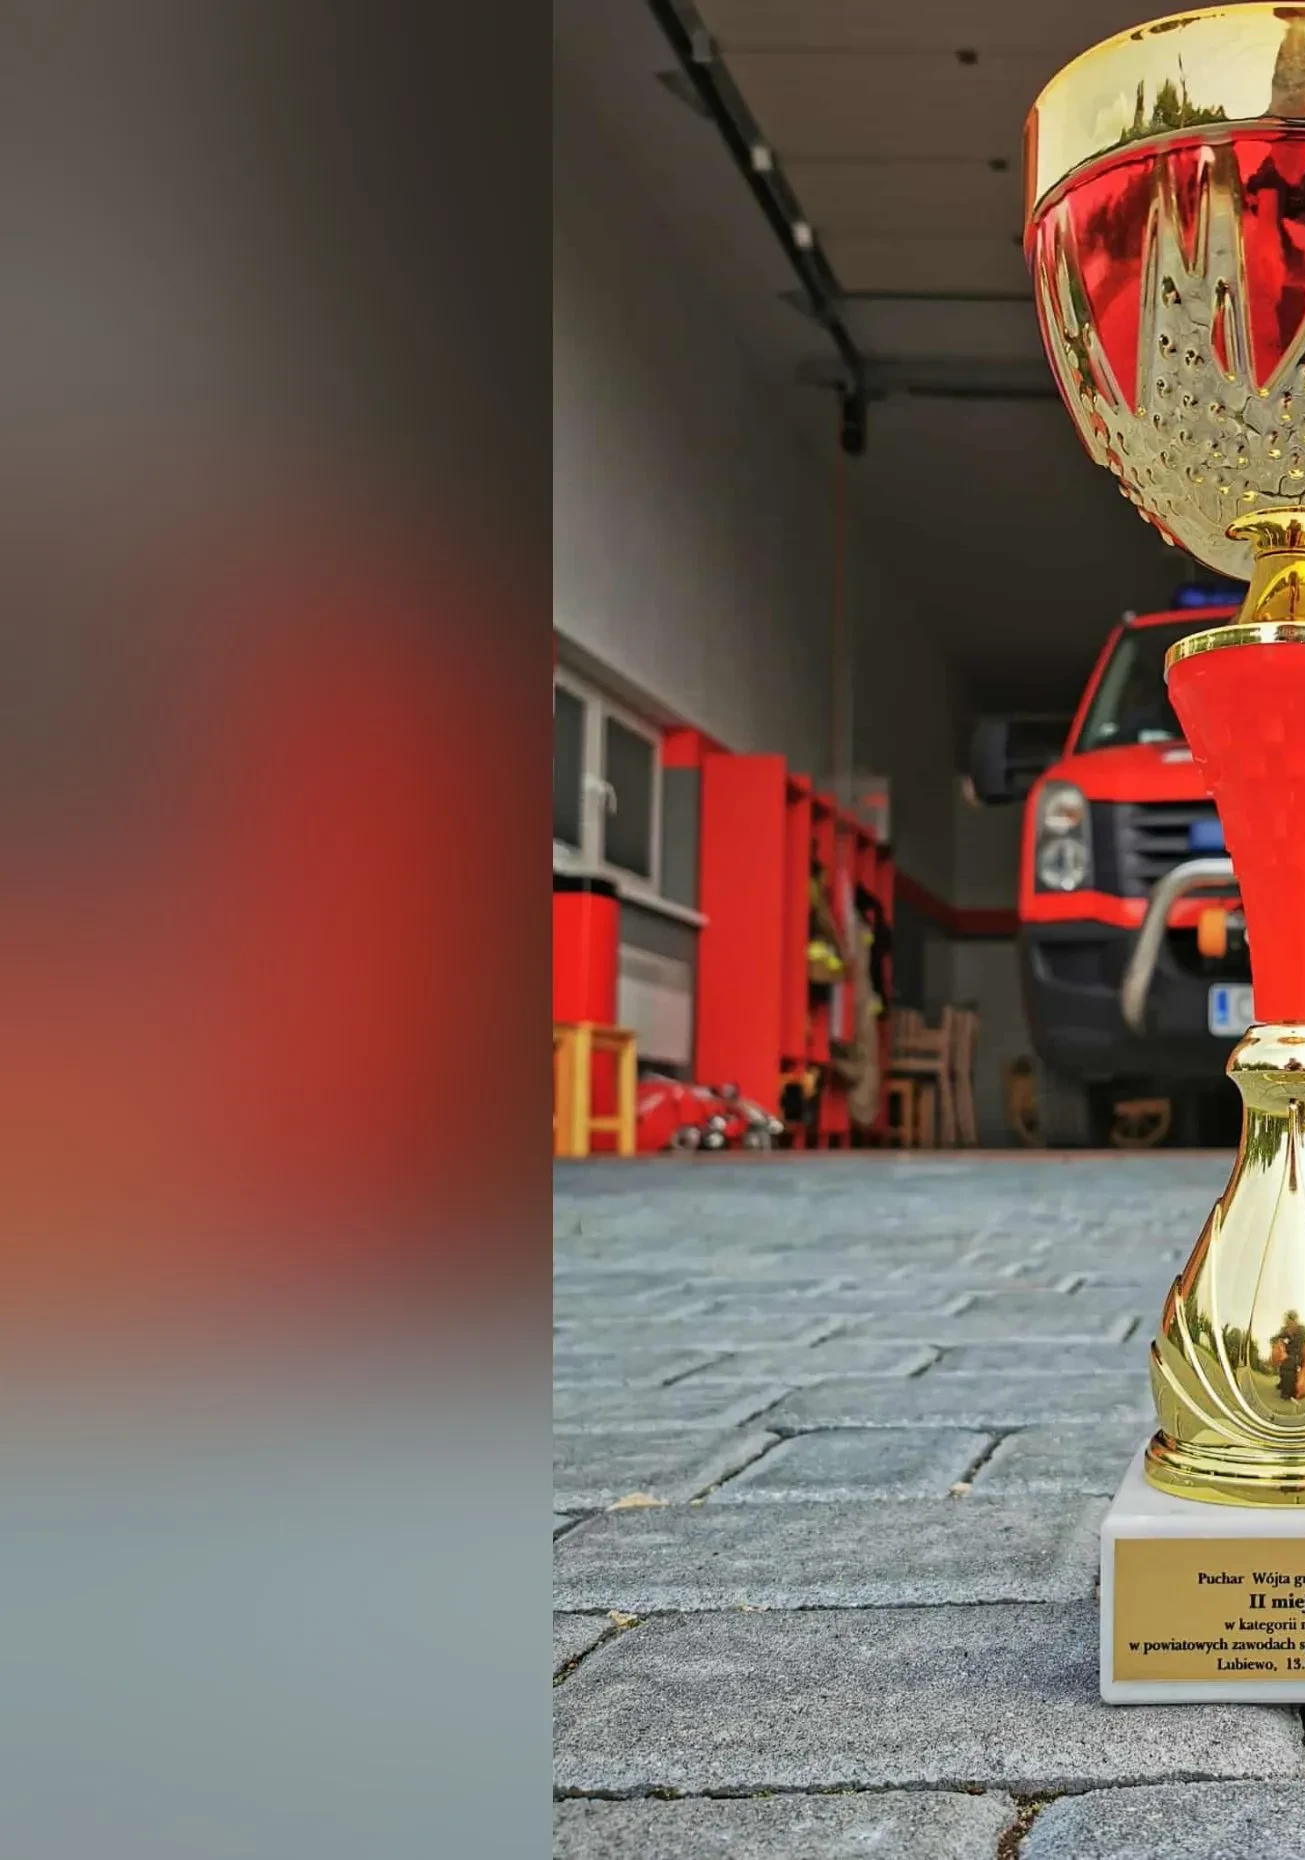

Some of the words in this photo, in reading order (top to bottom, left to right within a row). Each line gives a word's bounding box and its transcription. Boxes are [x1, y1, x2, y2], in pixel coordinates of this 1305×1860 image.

[1197, 1572, 1245, 1585] Puchar
[1252, 1572, 1291, 1588] Wójta
[1249, 1593, 1267, 1609] II
[1224, 1621, 1236, 1631] w
[1238, 1617, 1298, 1634] kategorii
[1128, 1641, 1140, 1651] w
[1142, 1637, 1229, 1655] powiatowych
[1231, 1637, 1296, 1651] zawodach
[1217, 1657, 1278, 1672] Lubiewo,
